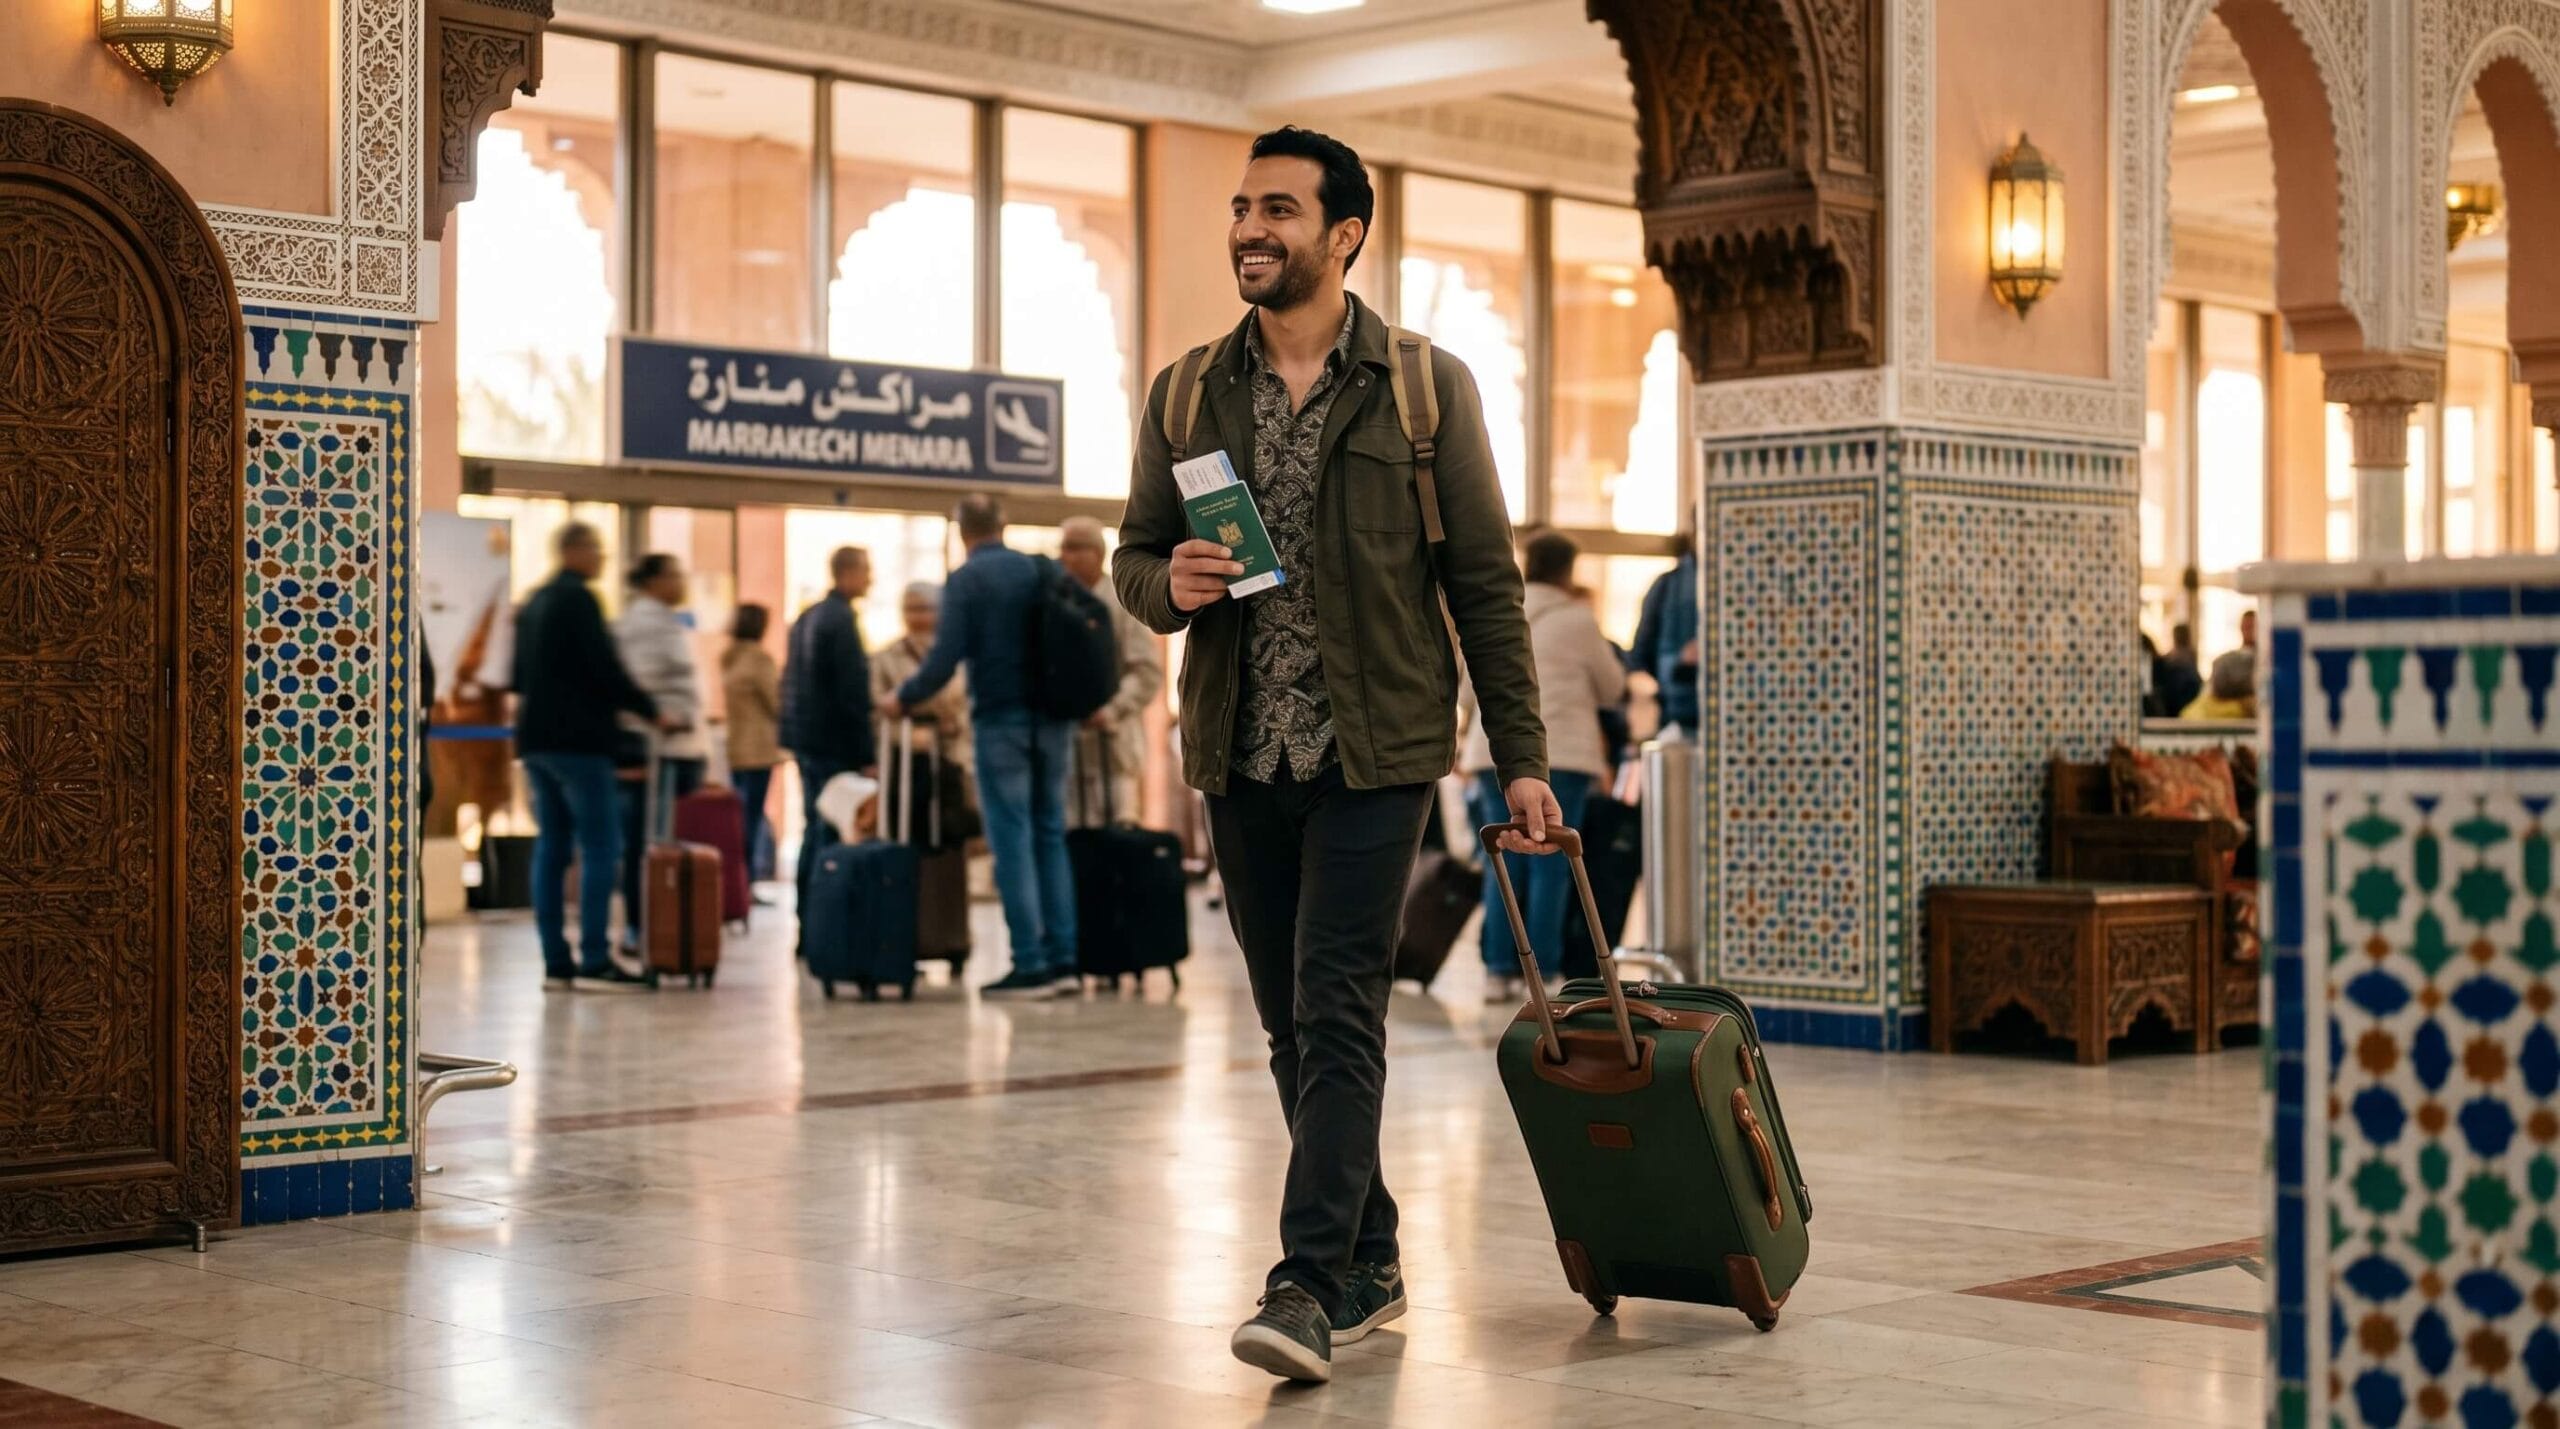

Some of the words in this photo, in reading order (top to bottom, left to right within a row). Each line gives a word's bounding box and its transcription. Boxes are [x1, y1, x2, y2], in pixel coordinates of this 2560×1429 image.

[688, 358, 805, 413] منارة
[813, 368, 972, 429] مراكش
[687, 420, 857, 463] MARRAKECH
[862, 433, 973, 471] MENARA
